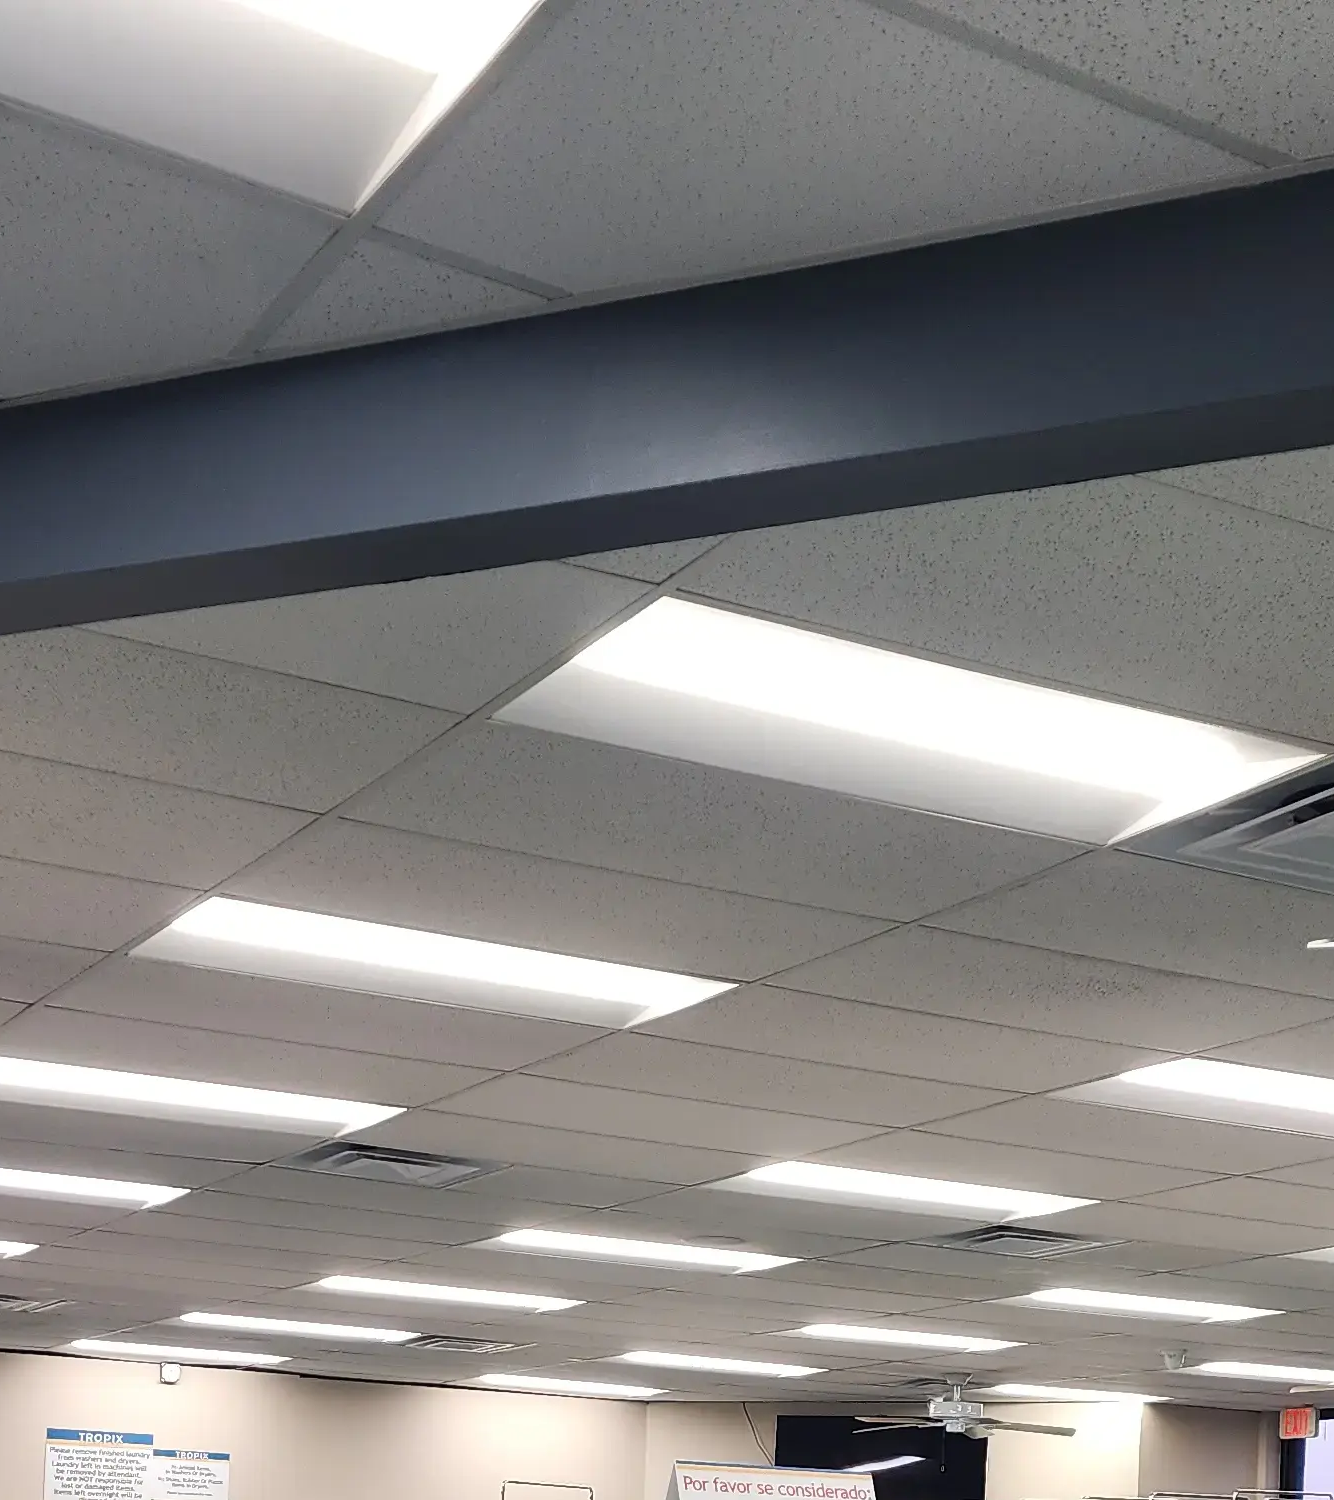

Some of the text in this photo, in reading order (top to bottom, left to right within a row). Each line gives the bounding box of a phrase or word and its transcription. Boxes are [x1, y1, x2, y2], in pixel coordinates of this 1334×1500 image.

[1284, 1408, 1311, 1437] EXIT
[79, 1433, 123, 1443] TROPIX
[175, 1451, 208, 1459] TROPIX
[683, 1476, 872, 1500] Por favor se considerado:
